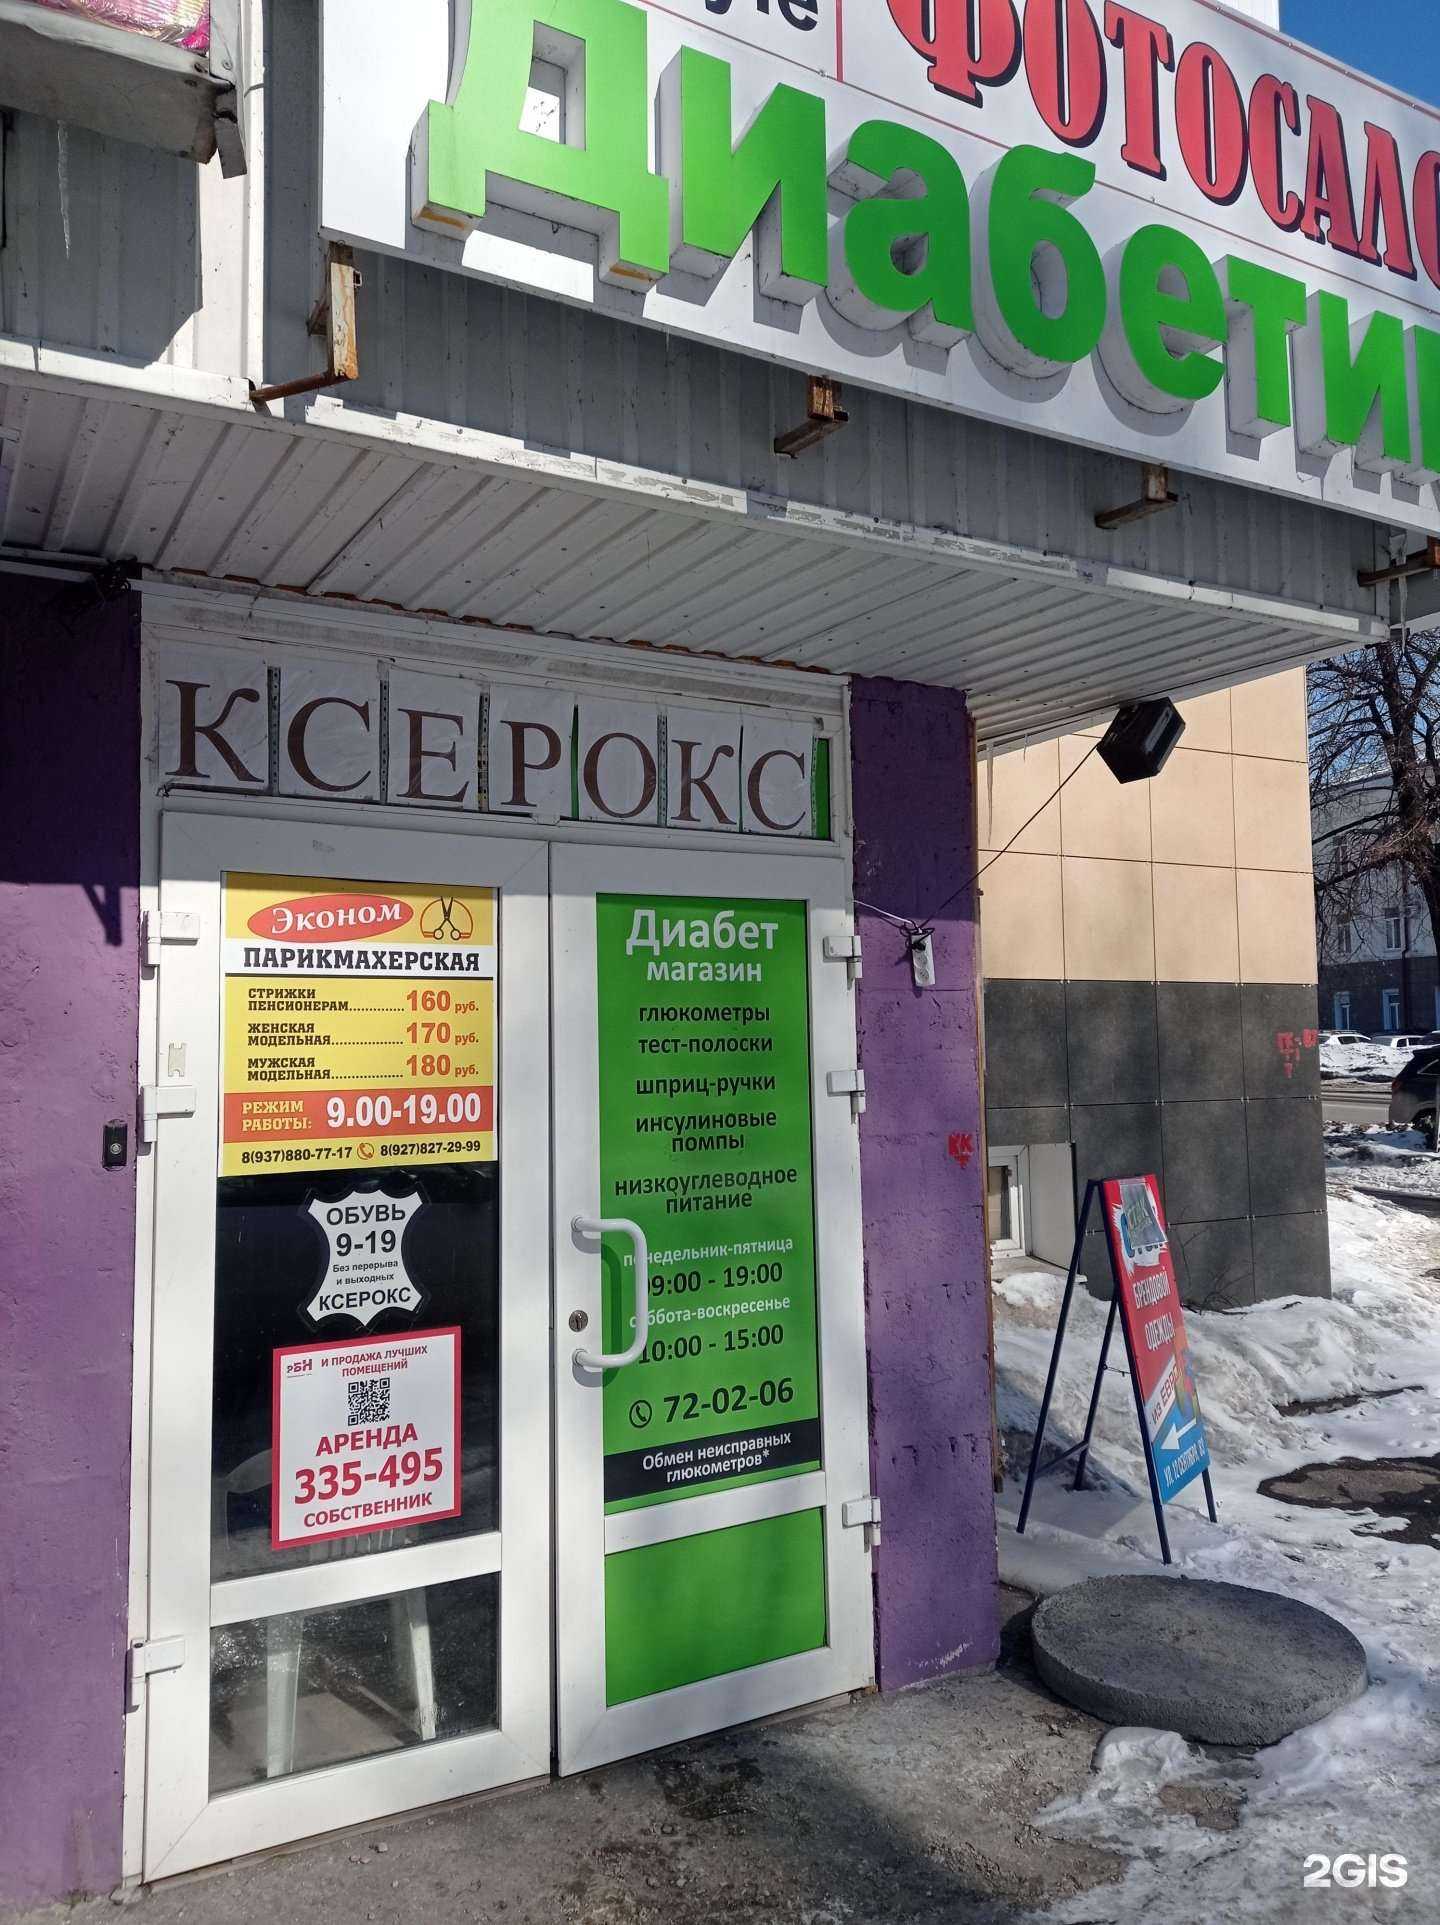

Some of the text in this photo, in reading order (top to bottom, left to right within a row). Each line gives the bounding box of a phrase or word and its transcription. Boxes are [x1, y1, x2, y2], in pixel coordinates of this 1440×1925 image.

[165, 679, 806, 831] КСЕРОКС
[271, 903, 402, 934] Эконом
[626, 909, 779, 956] Диабет
[244, 947, 480, 972] ПАРИКМАХЕРСКАЯ
[647, 961, 762, 982] магазин
[248, 988, 316, 999] СТРИЖКИ
[406, 990, 451, 1012] 160
[455, 1002, 479, 1014] руб.
[639, 1006, 770, 1025] глюкометры
[248, 1023, 315, 1034] ЖЕНСКАЯ
[406, 1022, 451, 1044] 170
[455, 1034, 479, 1046] руб.
[639, 1037, 773, 1053] тест-полоски
[248, 1057, 315, 1069] МУЖСКАЯ
[406, 1054, 451, 1077] 180
[455, 1066, 479, 1078] руб.
[636, 1075, 776, 1098] шприц-ручки
[242, 1101, 304, 1114] РЕЖИМ
[326, 1092, 481, 1128] 9.00-19.00
[242, 1117, 312, 1132] РАБОТЫ:
[636, 1111, 777, 1135] инсулиновые
[241, 1140, 481, 1164] 8(937)880-77-17 8(927)827-29-99
[672, 1134, 744, 1152] помпы
[615, 1168, 797, 1196] низкоуглеводное
[326, 1203, 406, 1225] ОБУВЬ
[666, 1192, 752, 1213] питание
[336, 1229, 396, 1257] 9-19
[333, 1260, 399, 1273] Без перерыва
[723, 1262, 783, 1288] 19:00
[345, 1273, 394, 1286] выходных
[319, 1286, 411, 1311] КСЕРОКС
[724, 1324, 784, 1351] 15:00
[321, 1345, 428, 1367] И ПРОДАЖА ЛУЧШИХ
[342, 1359, 408, 1377] ПОМЕЩЕНИЙ
[664, 1377, 794, 1423] 72-02-06
[316, 1423, 418, 1456] АРЕНДА
[642, 1432, 792, 1471] Обмен неисправных
[294, 1447, 443, 1505] 335-495
[303, 1492, 432, 1528] СОБСТВЕННИК
